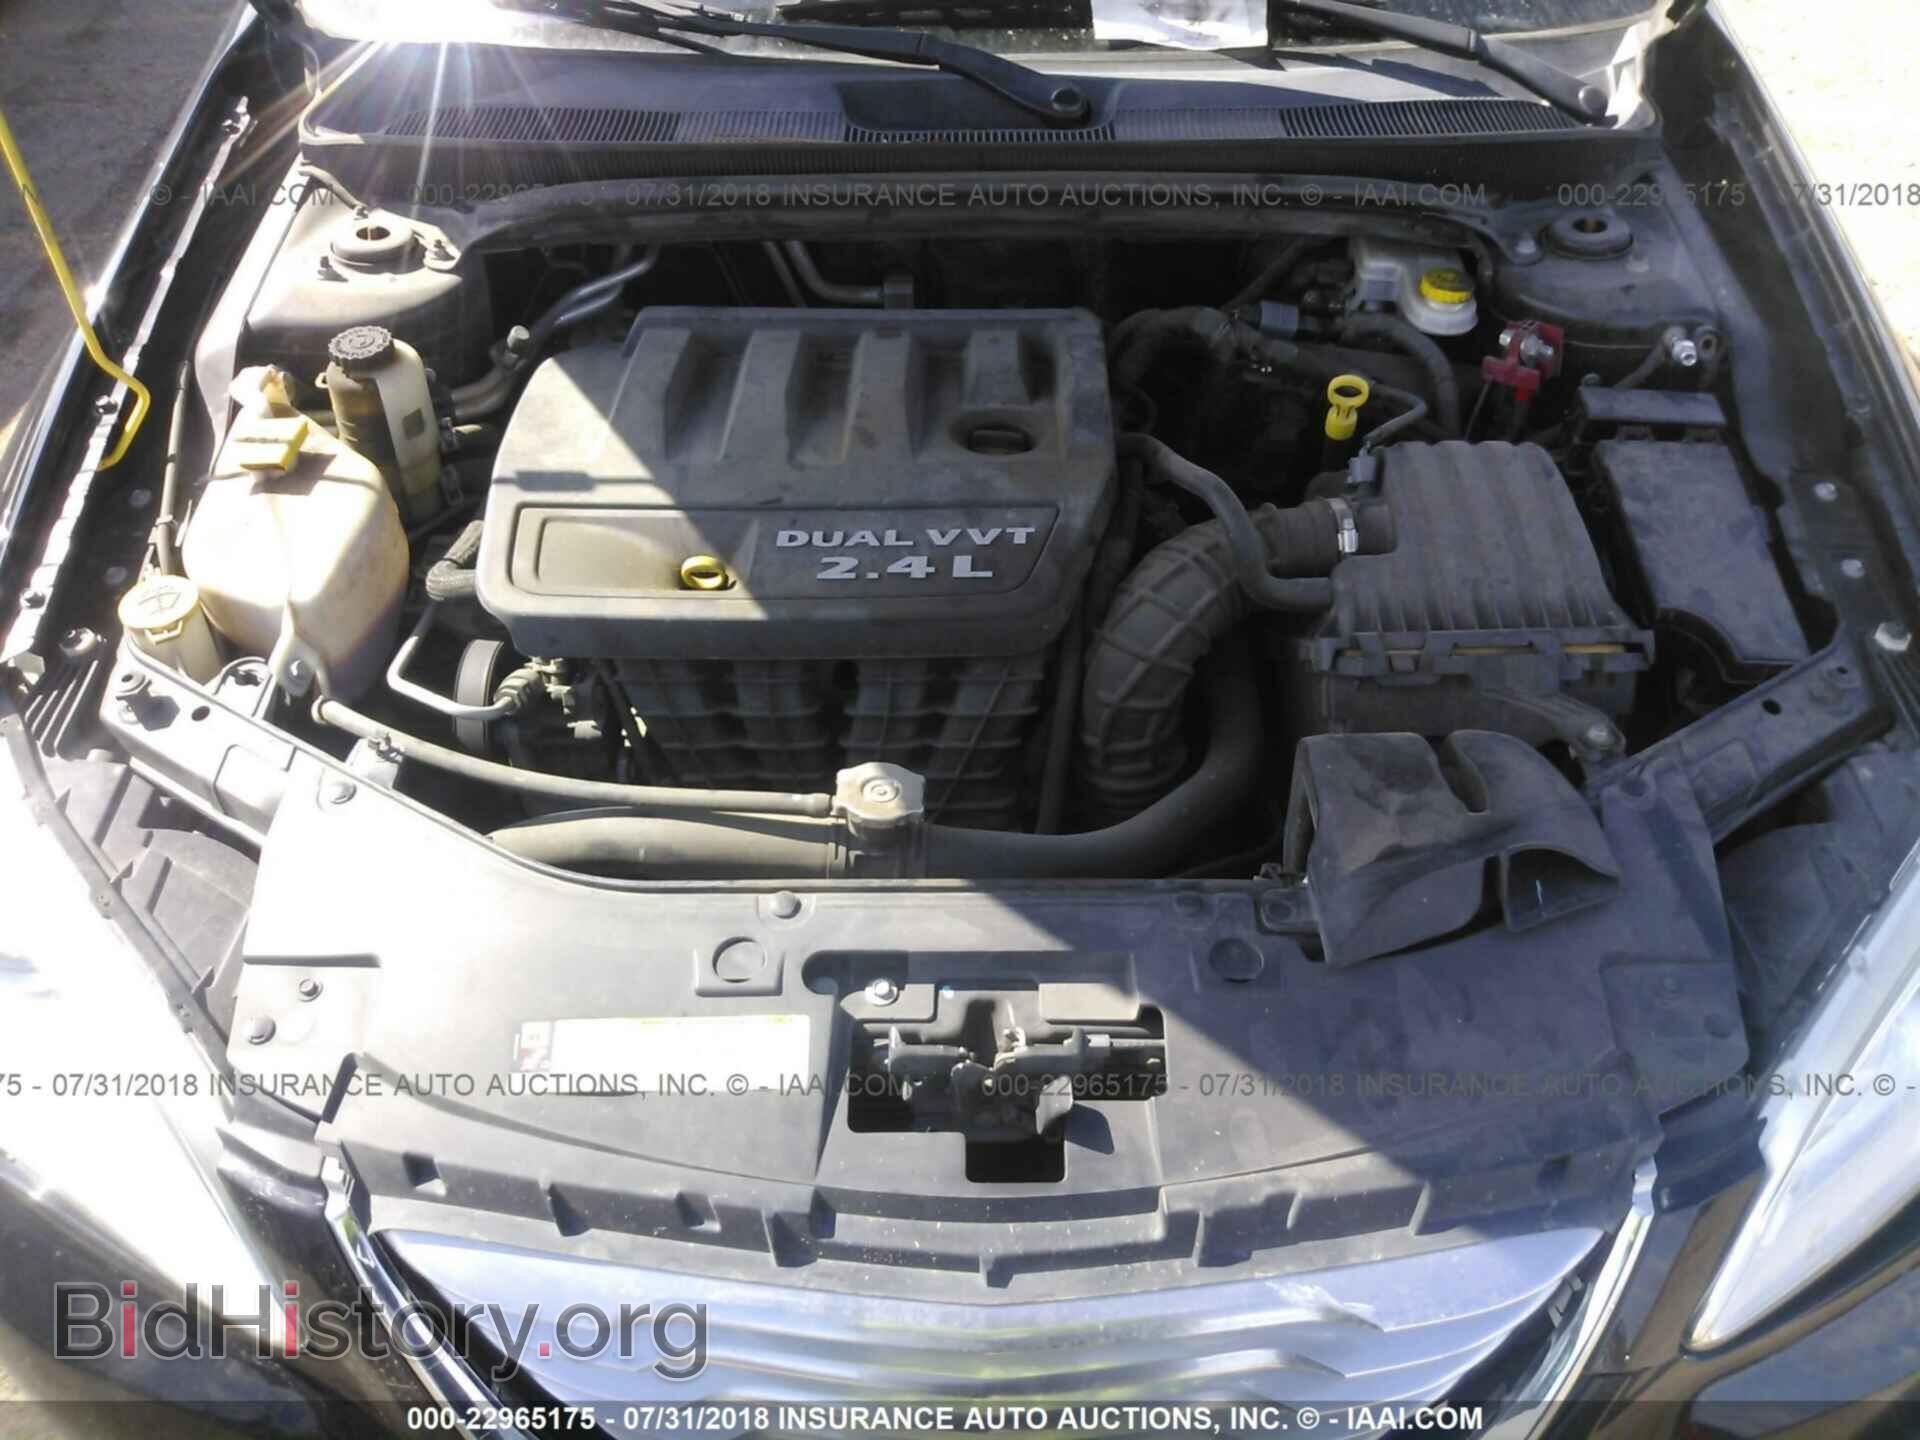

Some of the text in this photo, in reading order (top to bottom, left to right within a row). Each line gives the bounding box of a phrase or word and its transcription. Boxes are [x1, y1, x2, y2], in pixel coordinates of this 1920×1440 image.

[776, 527, 1036, 548] DUAL VVT
[816, 555, 993, 579] 2.4 L
